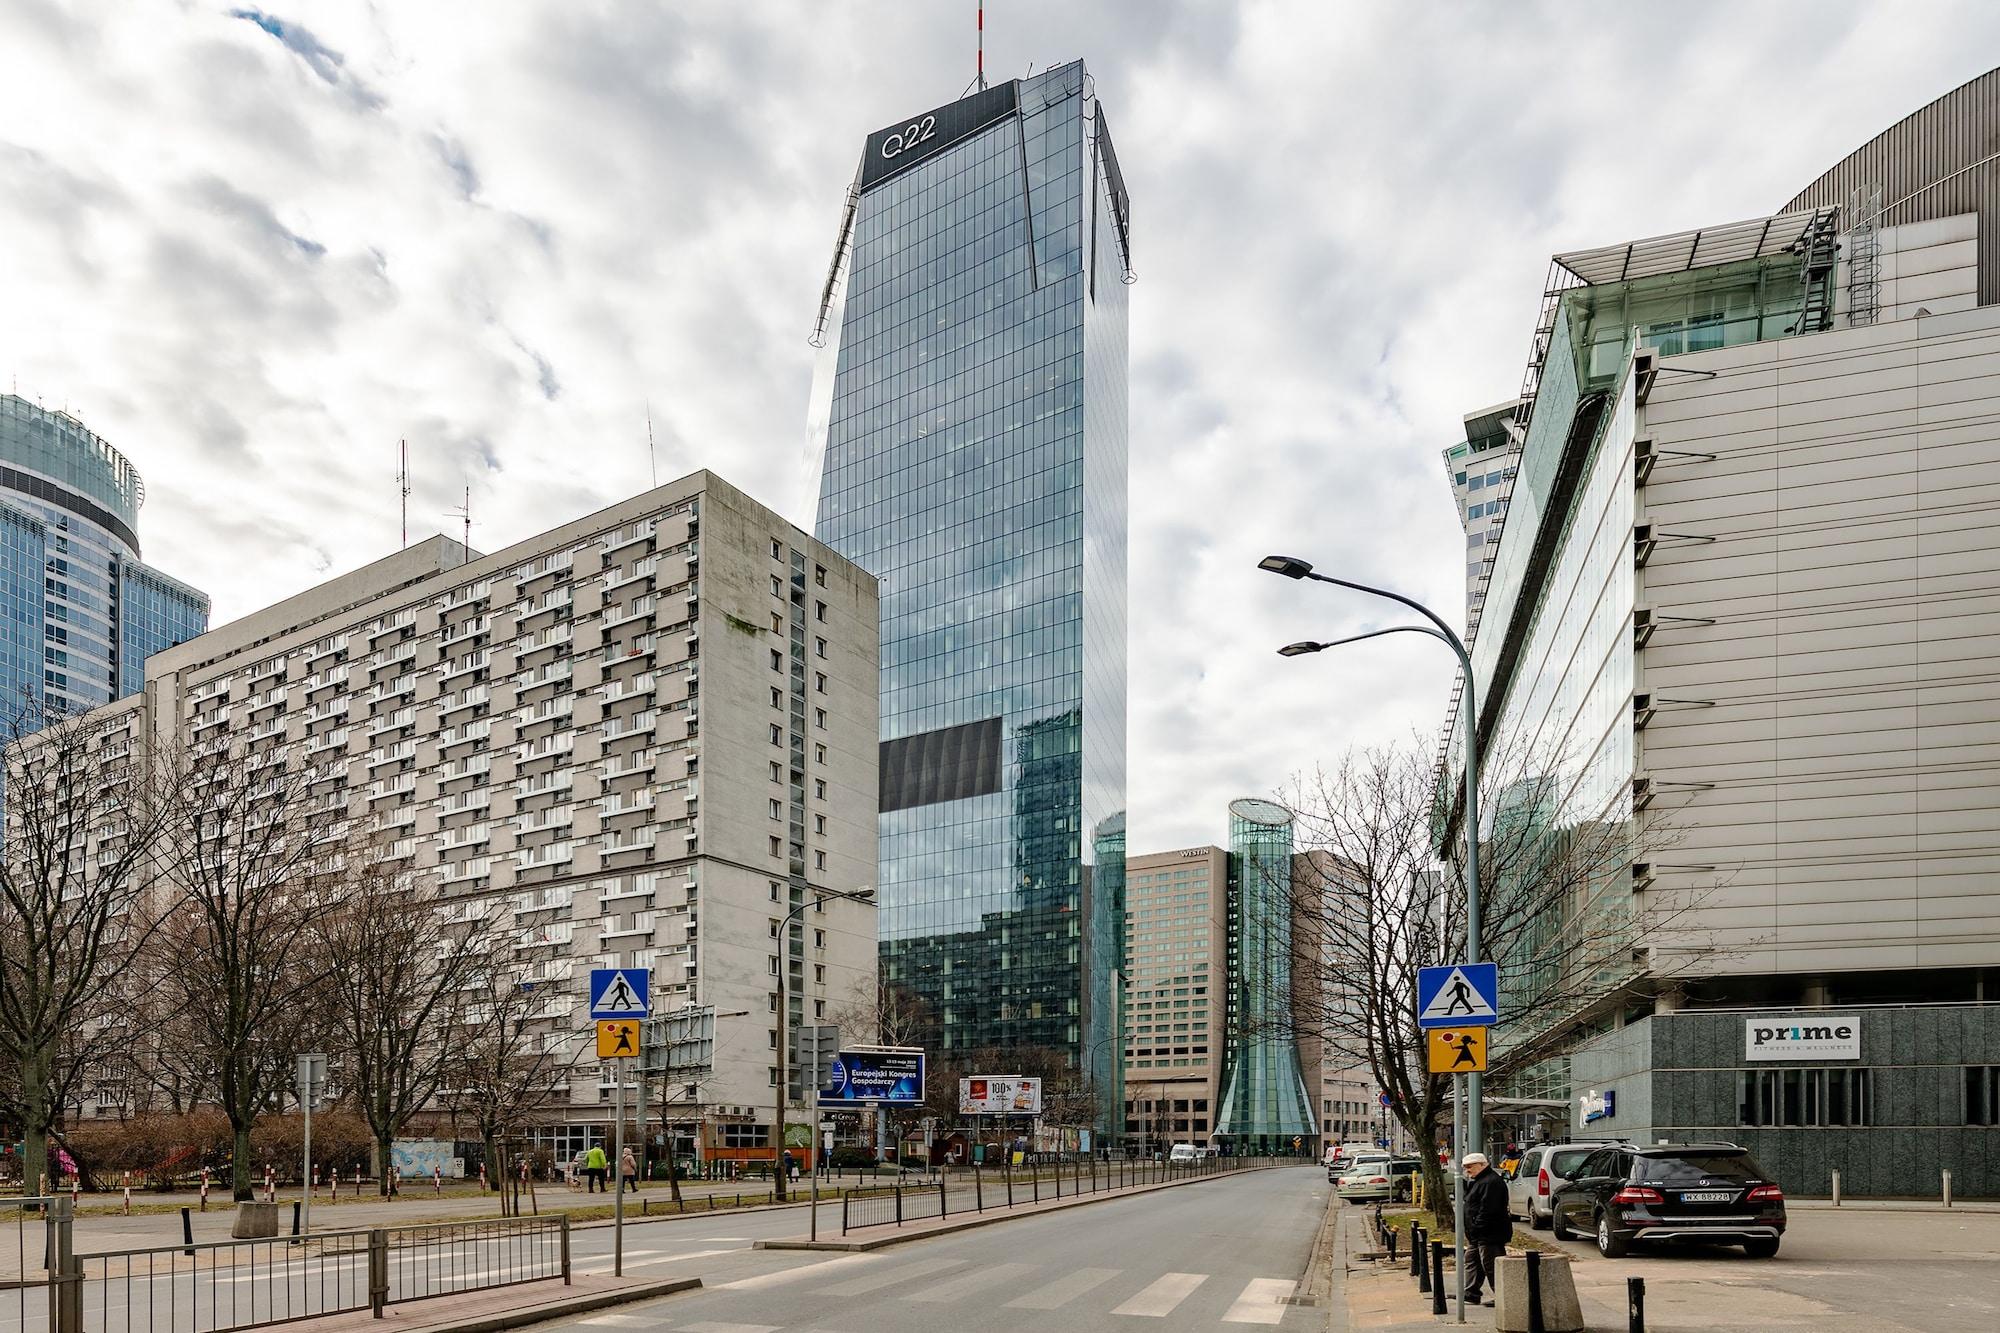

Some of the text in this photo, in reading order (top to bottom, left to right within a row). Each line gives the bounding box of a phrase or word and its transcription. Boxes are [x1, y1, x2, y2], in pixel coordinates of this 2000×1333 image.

[882, 115, 935, 158] Q22
[1180, 848, 1209, 857] WESTIN
[851, 1069, 888, 1079] Europejski
[889, 1070, 917, 1079] Kongres
[851, 1077, 896, 1086] Gospodarczy
[992, 1082, 1012, 1094] 100%
